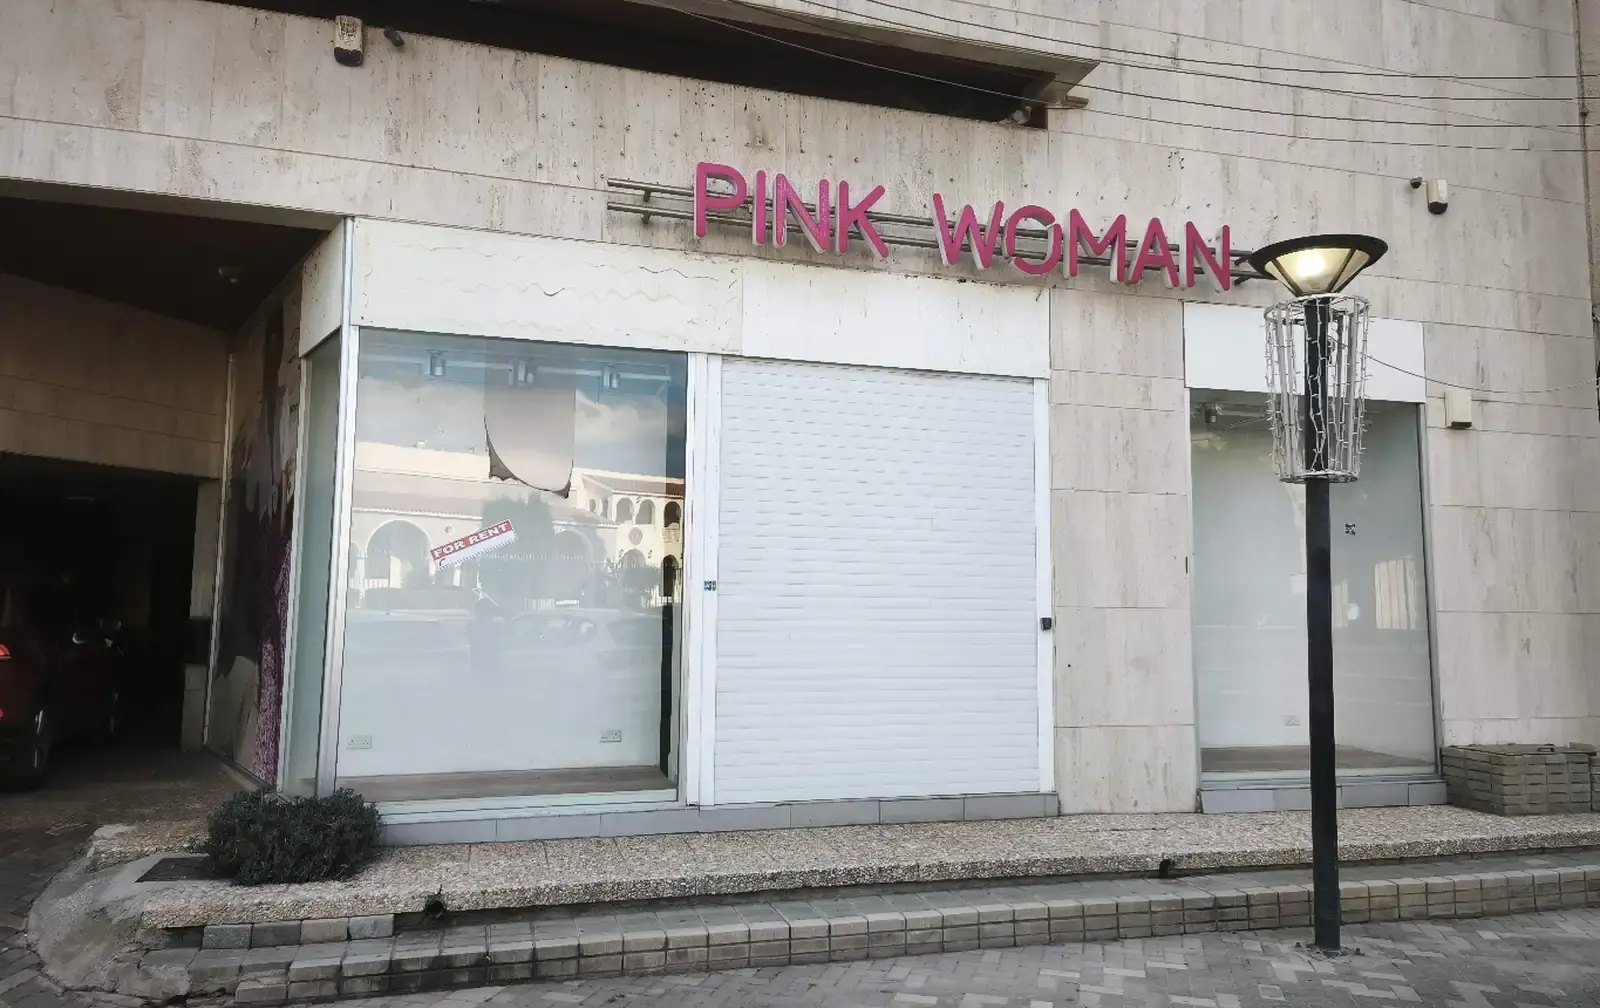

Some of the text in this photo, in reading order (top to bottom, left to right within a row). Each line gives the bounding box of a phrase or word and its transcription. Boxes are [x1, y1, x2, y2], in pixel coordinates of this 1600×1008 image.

[694, 162, 1231, 292] PINK WOMAN
[433, 522, 509, 559] FOR RENT
